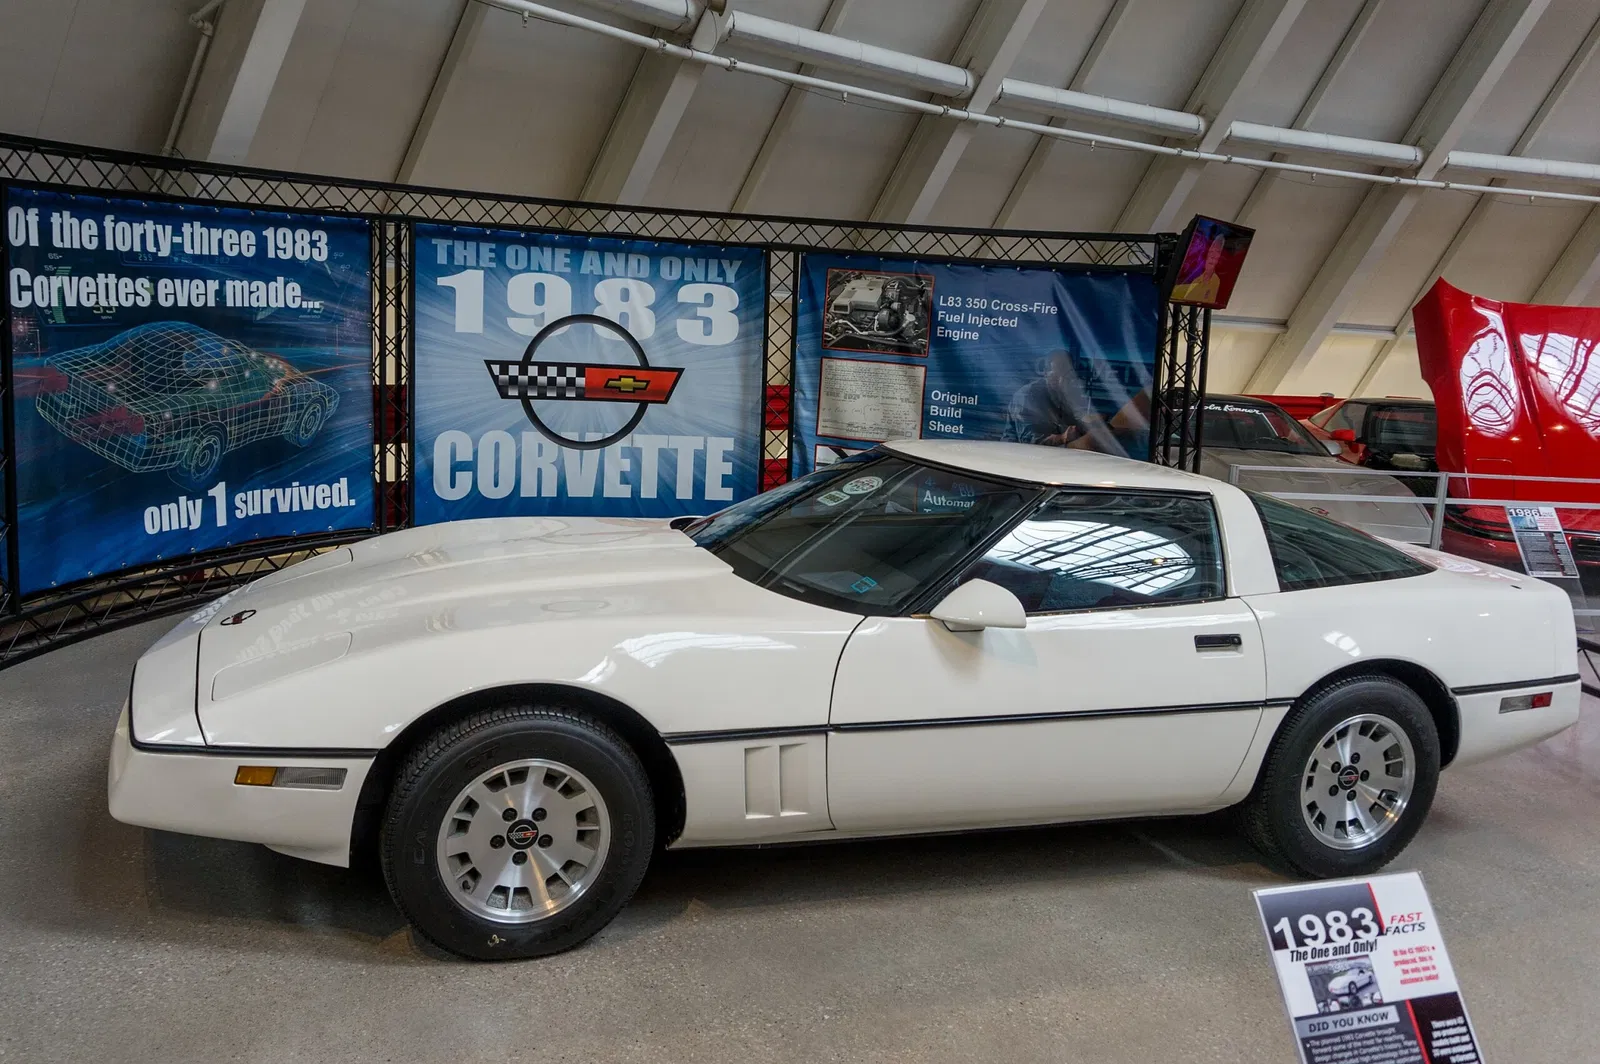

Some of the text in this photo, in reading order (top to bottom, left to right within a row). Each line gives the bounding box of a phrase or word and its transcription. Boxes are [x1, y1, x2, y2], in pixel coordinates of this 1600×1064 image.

[8, 206, 328, 262] Of the forty-three 1983
[432, 238, 743, 284] THE ONE AND ONLY
[10, 268, 320, 308] Corvettes ever made...
[437, 269, 740, 346] 1983
[939, 295, 1058, 315] L83 350 Cross-Fire
[937, 311, 1018, 328] Fuel Injected
[936, 326, 979, 341] Engine
[931, 390, 978, 406] Original
[930, 404, 962, 419] Build
[928, 420, 964, 435] Sheet
[433, 430, 735, 501] CORVETTE
[144, 477, 356, 535] only 1 survived.
[1509, 508, 1540, 517] 1986
[1273, 907, 1379, 950] 1983
[1390, 912, 1423, 925] FAST
[1384, 922, 1426, 936] FACTS
[1290, 938, 1378, 963] The One and Only!
[1308, 1012, 1390, 1033] DID YOU KNOW
